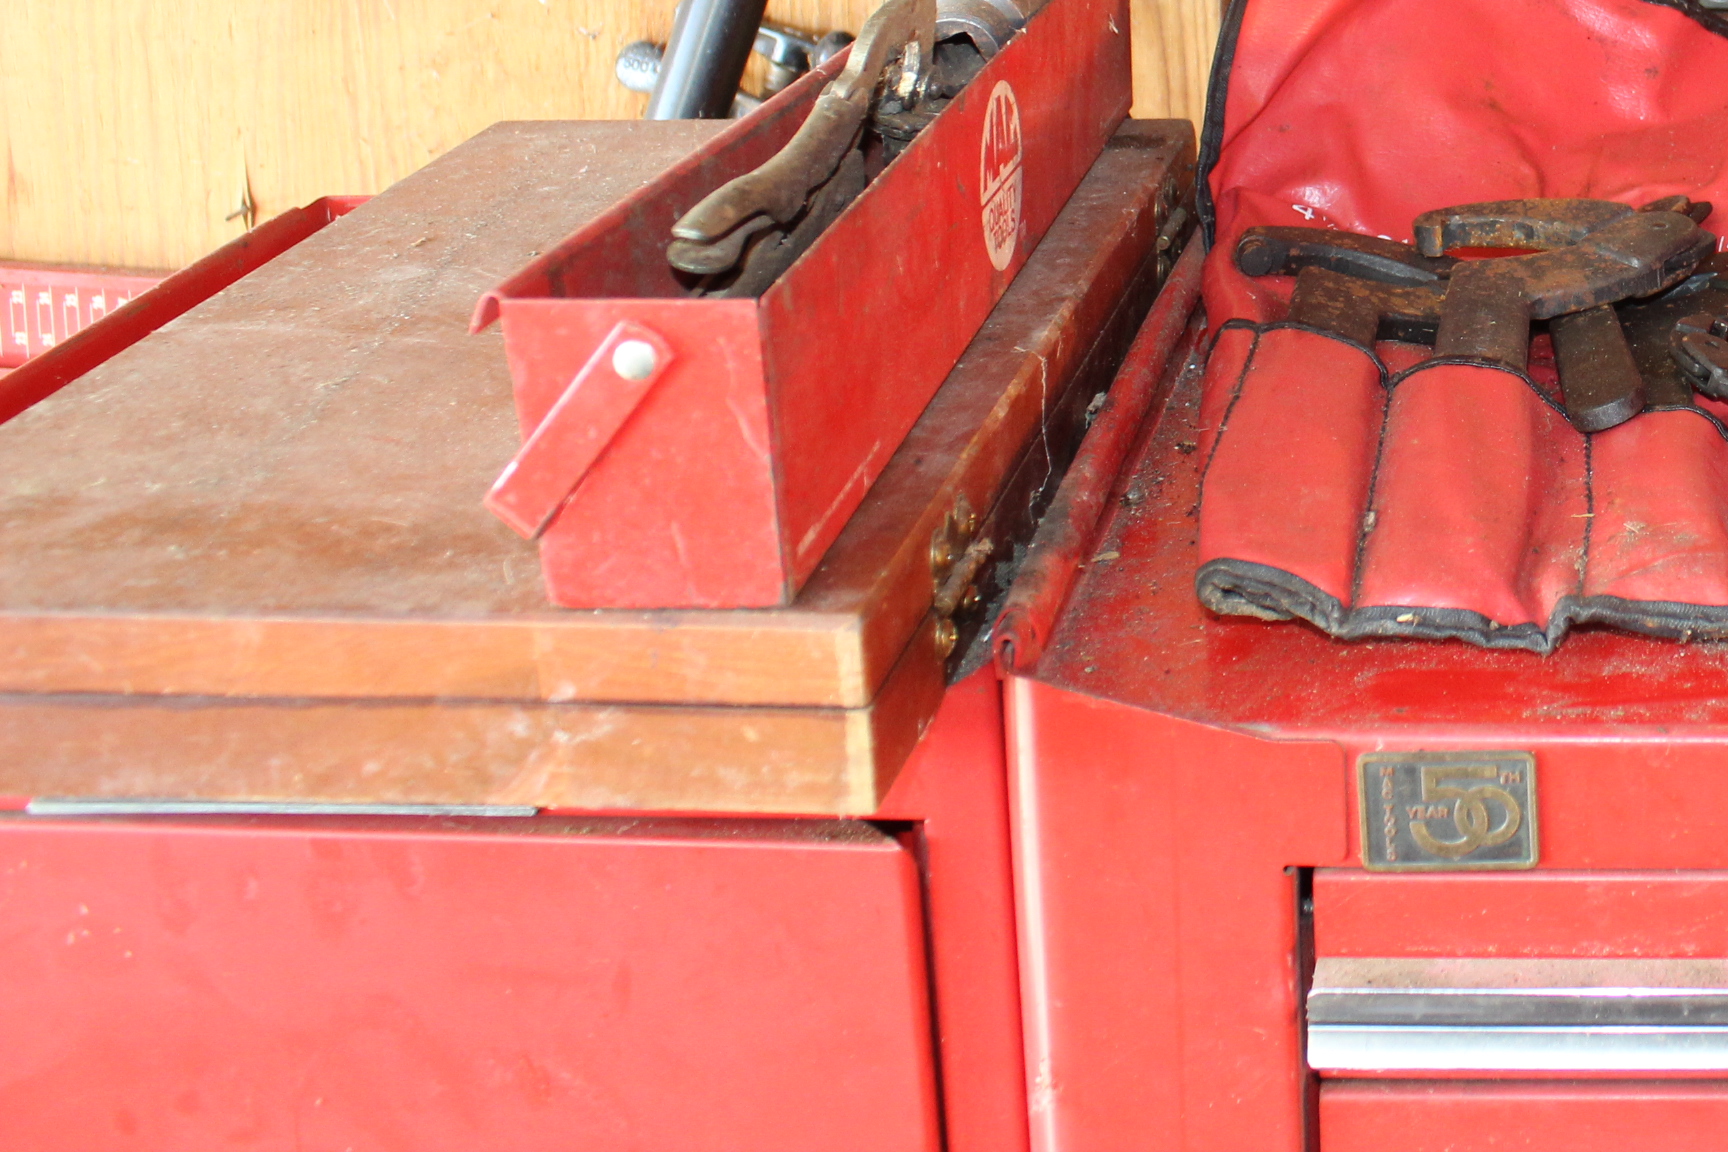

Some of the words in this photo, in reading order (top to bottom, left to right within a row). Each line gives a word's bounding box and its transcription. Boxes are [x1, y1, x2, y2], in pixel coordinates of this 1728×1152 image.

[983, 94, 1019, 196] MAC
[988, 184, 1017, 230] QUALITY
[1380, 767, 1395, 800] MAC
[1406, 805, 1450, 820] YEAR
